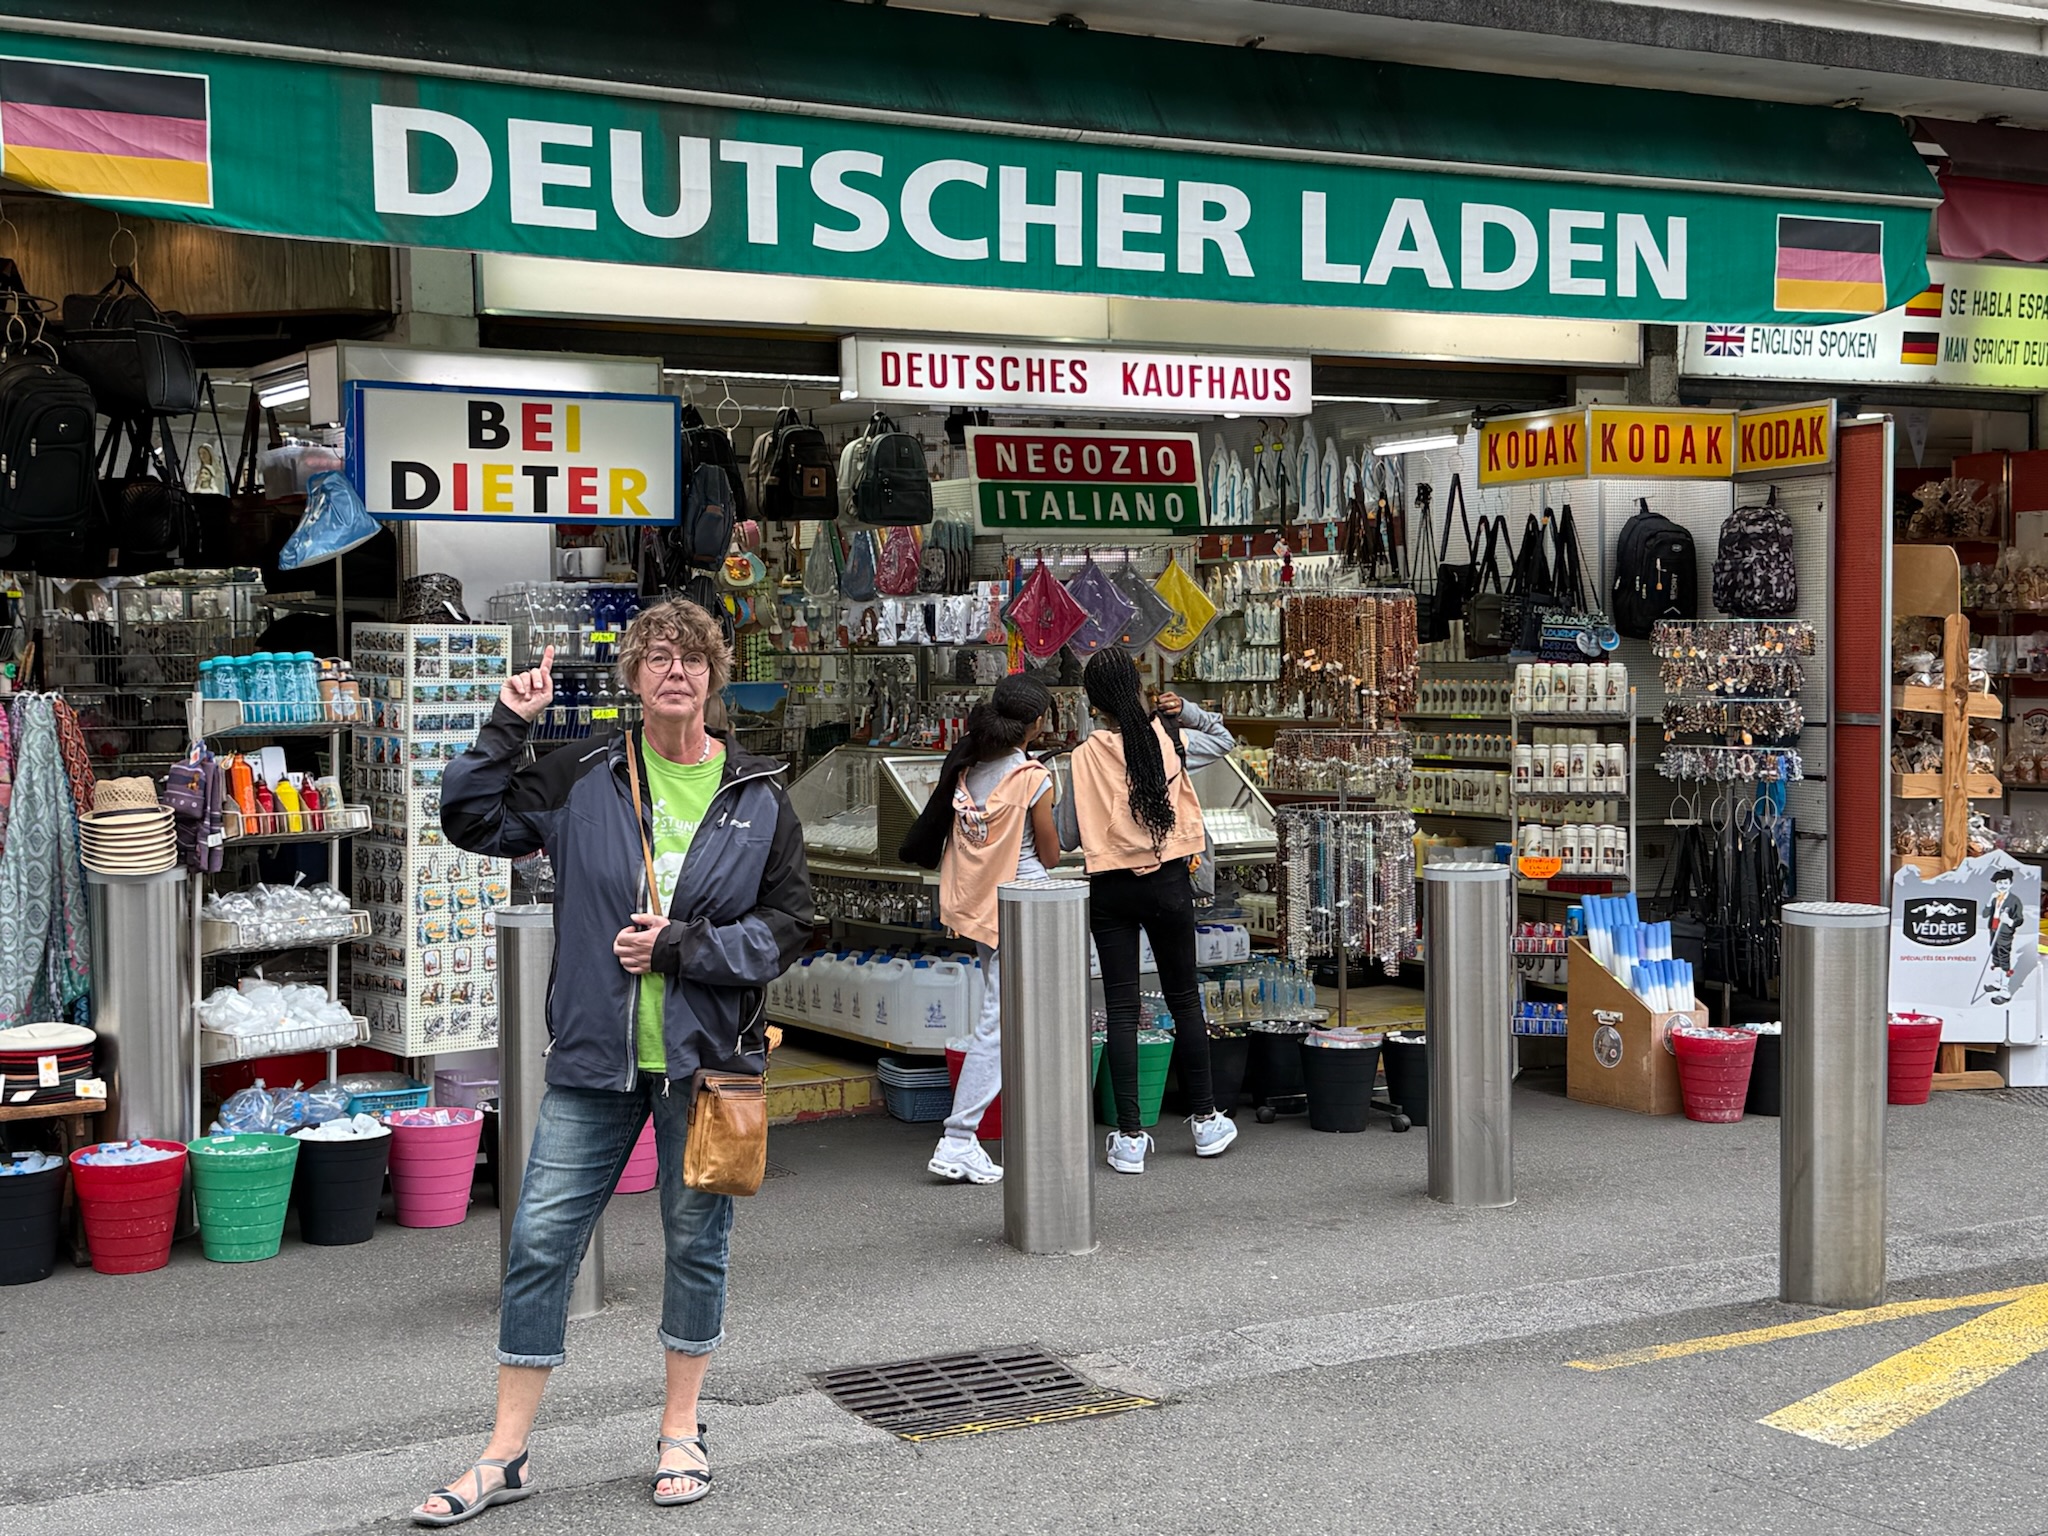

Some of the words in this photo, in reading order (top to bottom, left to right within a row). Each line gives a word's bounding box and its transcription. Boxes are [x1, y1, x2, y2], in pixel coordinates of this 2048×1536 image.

[370, 103, 1255, 279] DEUTSCHER
[1301, 190, 1687, 300] LADEN
[1950, 288, 1967, 315] SE
[1972, 290, 2012, 318] HABLA
[1751, 327, 1813, 356] ENGLISH
[1818, 330, 1877, 358] SPOKEN
[1943, 336, 1968, 363] MAN
[1973, 337, 2020, 366] SPRICHT
[881, 351, 1088, 394] DEUTSCHES
[1122, 362, 1291, 401] KAUFHAUS
[468, 400, 580, 452] BEI
[1488, 423, 1578, 471] KODAK
[1601, 422, 1723, 465] KODAK
[1742, 414, 1825, 463] KODAK
[996, 442, 1177, 476] NEGOZIO
[391, 460, 652, 516] DIETER
[997, 489, 1184, 523] ITALIANO
[1912, 919, 1967, 935] VÉDÈRE
